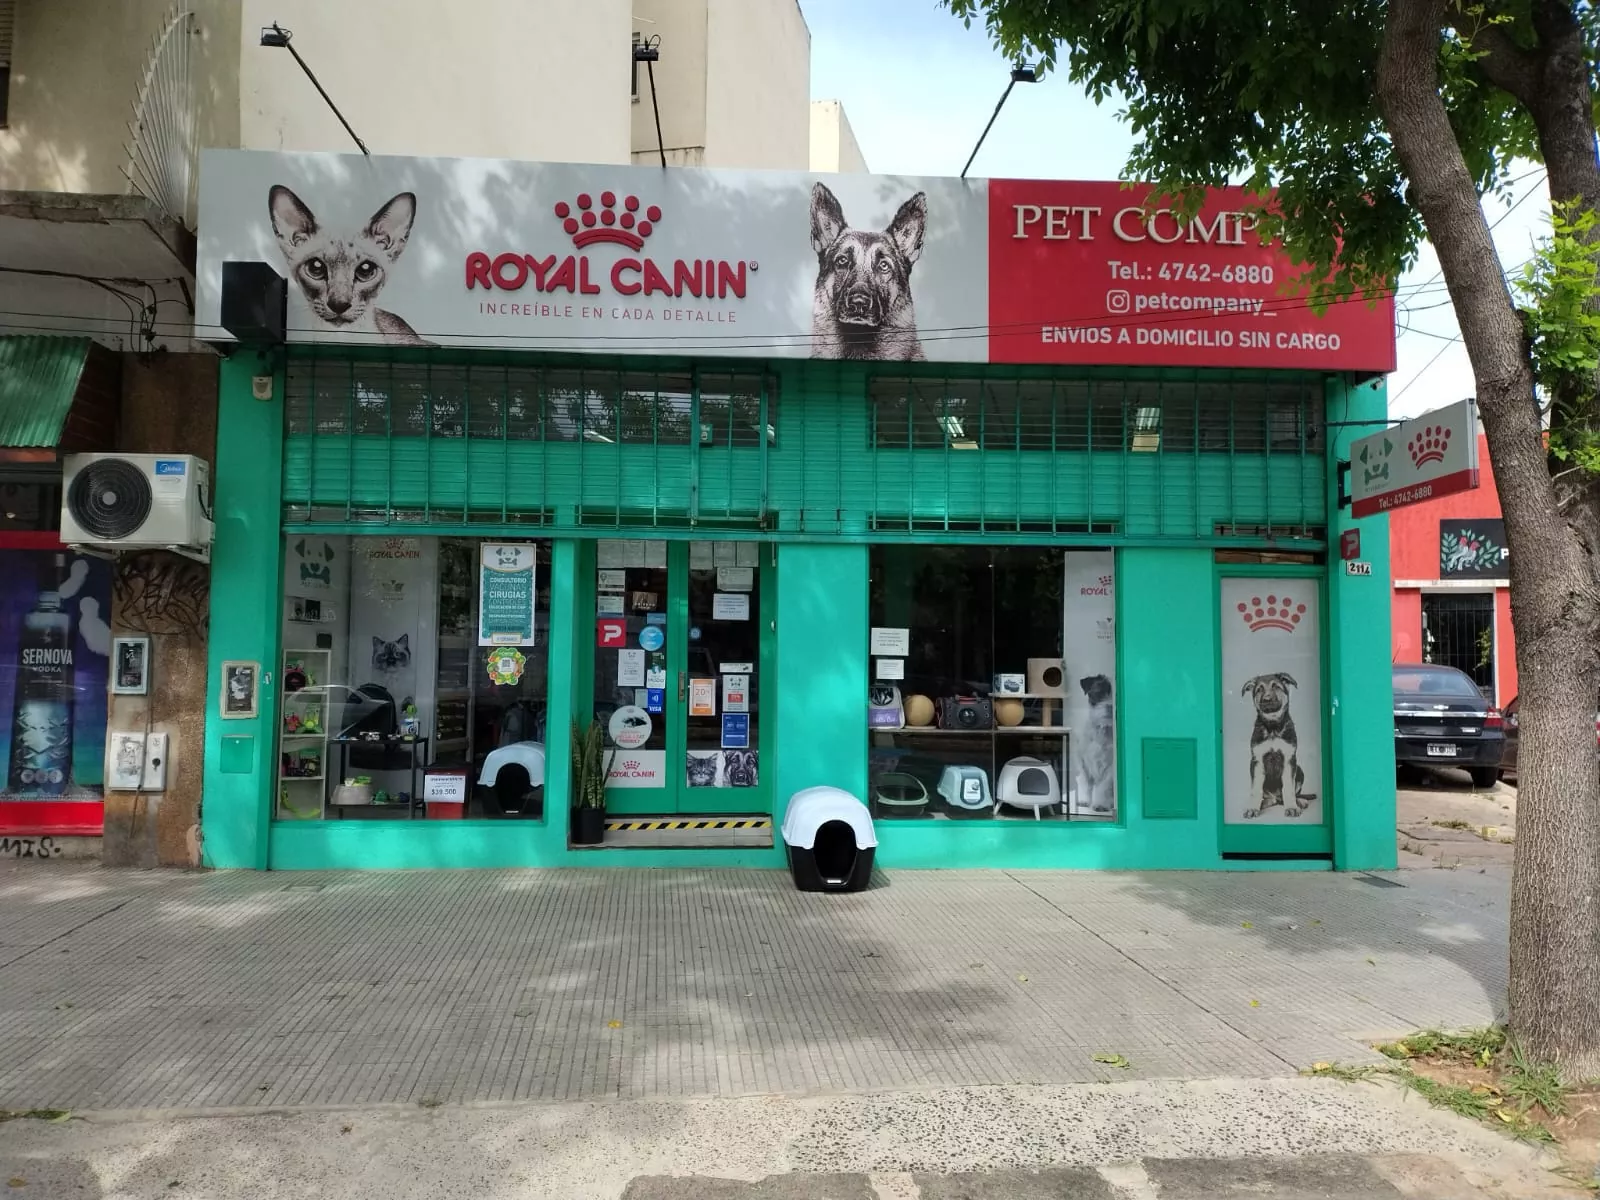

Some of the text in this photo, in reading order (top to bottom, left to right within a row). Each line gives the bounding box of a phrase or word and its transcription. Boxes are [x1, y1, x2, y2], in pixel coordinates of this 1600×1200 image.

[1012, 204, 1101, 241] PET
[465, 252, 600, 294] ROYAL
[1108, 260, 1274, 285] Tel.: 4742-6880
[479, 302, 736, 323] INCREÍBLE EN CADA DETALLE
[1117, 328, 1131, 345] A
[1136, 329, 1233, 348] DOMICILIO
[1239, 331, 1270, 349] SIN
[1275, 333, 1341, 351] CARGO
[489, 591, 527, 599] CIRUGIAS
[1081, 587, 1108, 596] ROYAL
[22, 648, 73, 665] SERNOVA
[631, 770, 655, 778] CANIN
